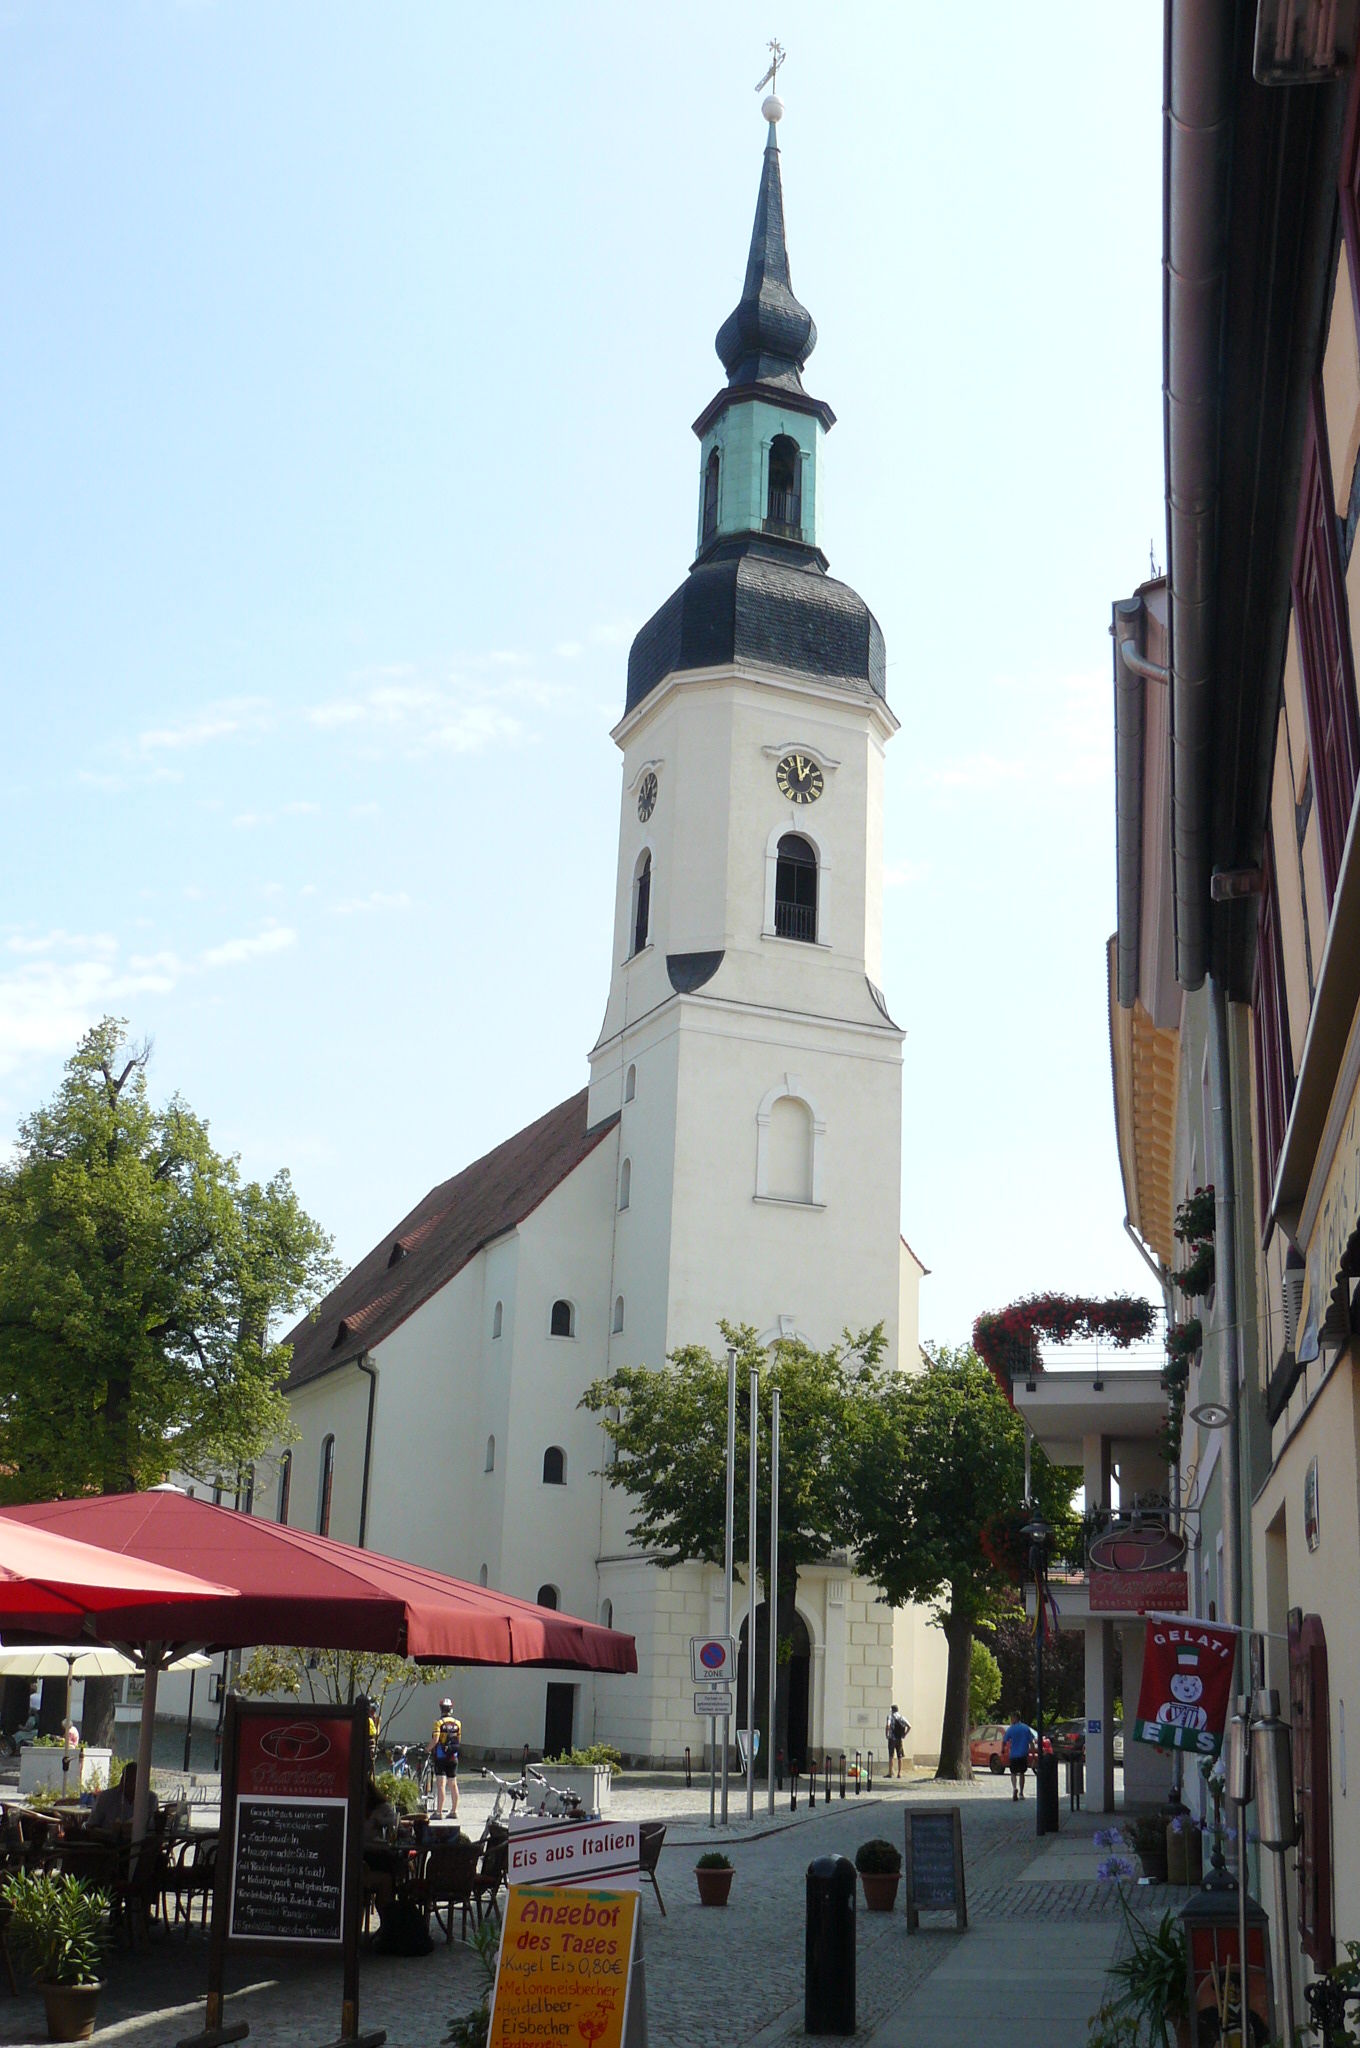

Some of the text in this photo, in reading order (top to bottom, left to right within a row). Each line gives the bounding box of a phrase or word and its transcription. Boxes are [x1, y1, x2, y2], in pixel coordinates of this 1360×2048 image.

[1154, 1630, 1230, 1657] GELATI
[1141, 1721, 1215, 1751] EIS
[512, 1833, 635, 1868] Eis aus Italien
[520, 1900, 621, 1928] Angebot
[516, 1930, 618, 1956] des Tages
[505, 1953, 624, 1978] Kugel Eis 0,80€
[504, 1979, 620, 1997] Meloneneisbecher
[502, 1995, 582, 2016] Heidelbeer-
[502, 2016, 572, 2036] Eisbecher
